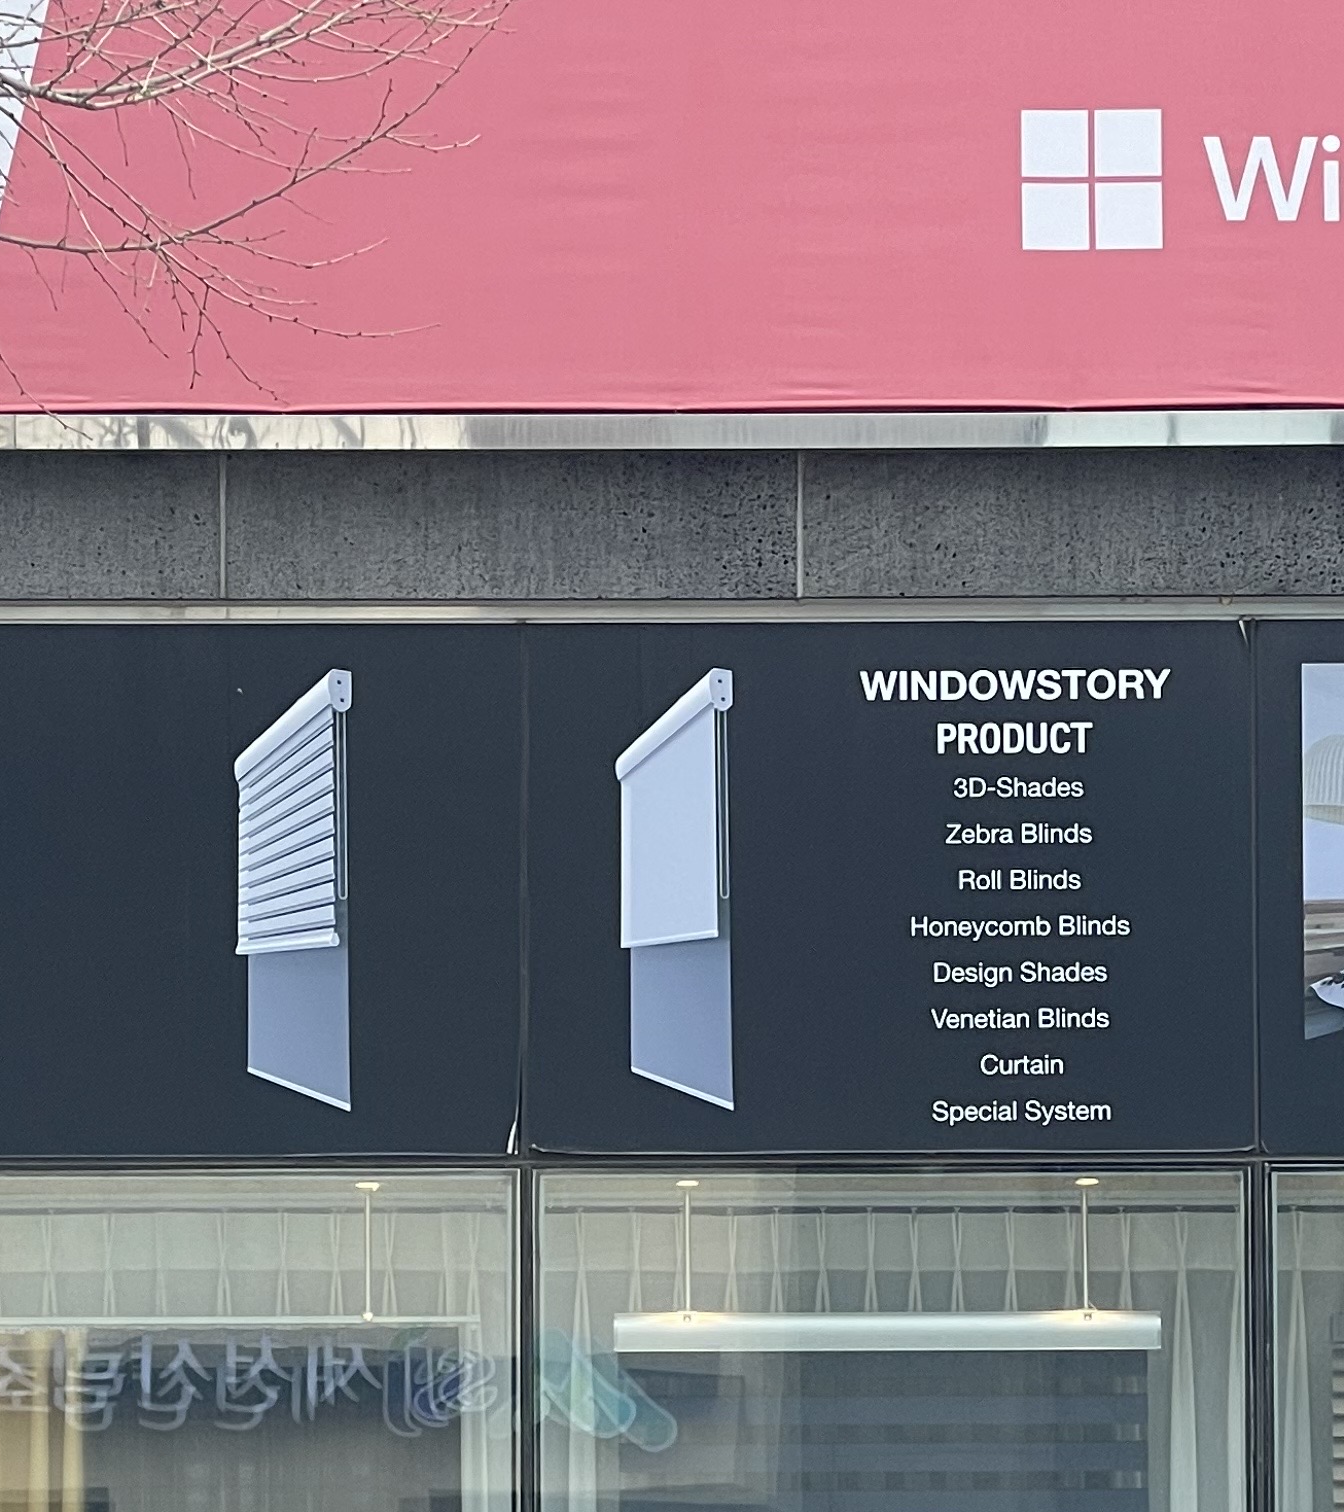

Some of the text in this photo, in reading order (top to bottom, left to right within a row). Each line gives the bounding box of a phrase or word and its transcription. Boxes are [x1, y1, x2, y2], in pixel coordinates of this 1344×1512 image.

[859, 668, 1171, 701] WINDOWSTORY
[937, 721, 1094, 754] PRODUCT
[953, 776, 1085, 799] 3D-Shades
[945, 822, 1093, 845] Zebra Blinds
[958, 869, 1082, 890] Roll Blinds
[910, 914, 1131, 942] Honeycomb Blinds
[933, 961, 1108, 988] Design Shades
[930, 1007, 1110, 1029] Venetian Blinds
[980, 1053, 1064, 1076] Curtain
[932, 1099, 1112, 1127] Special System
